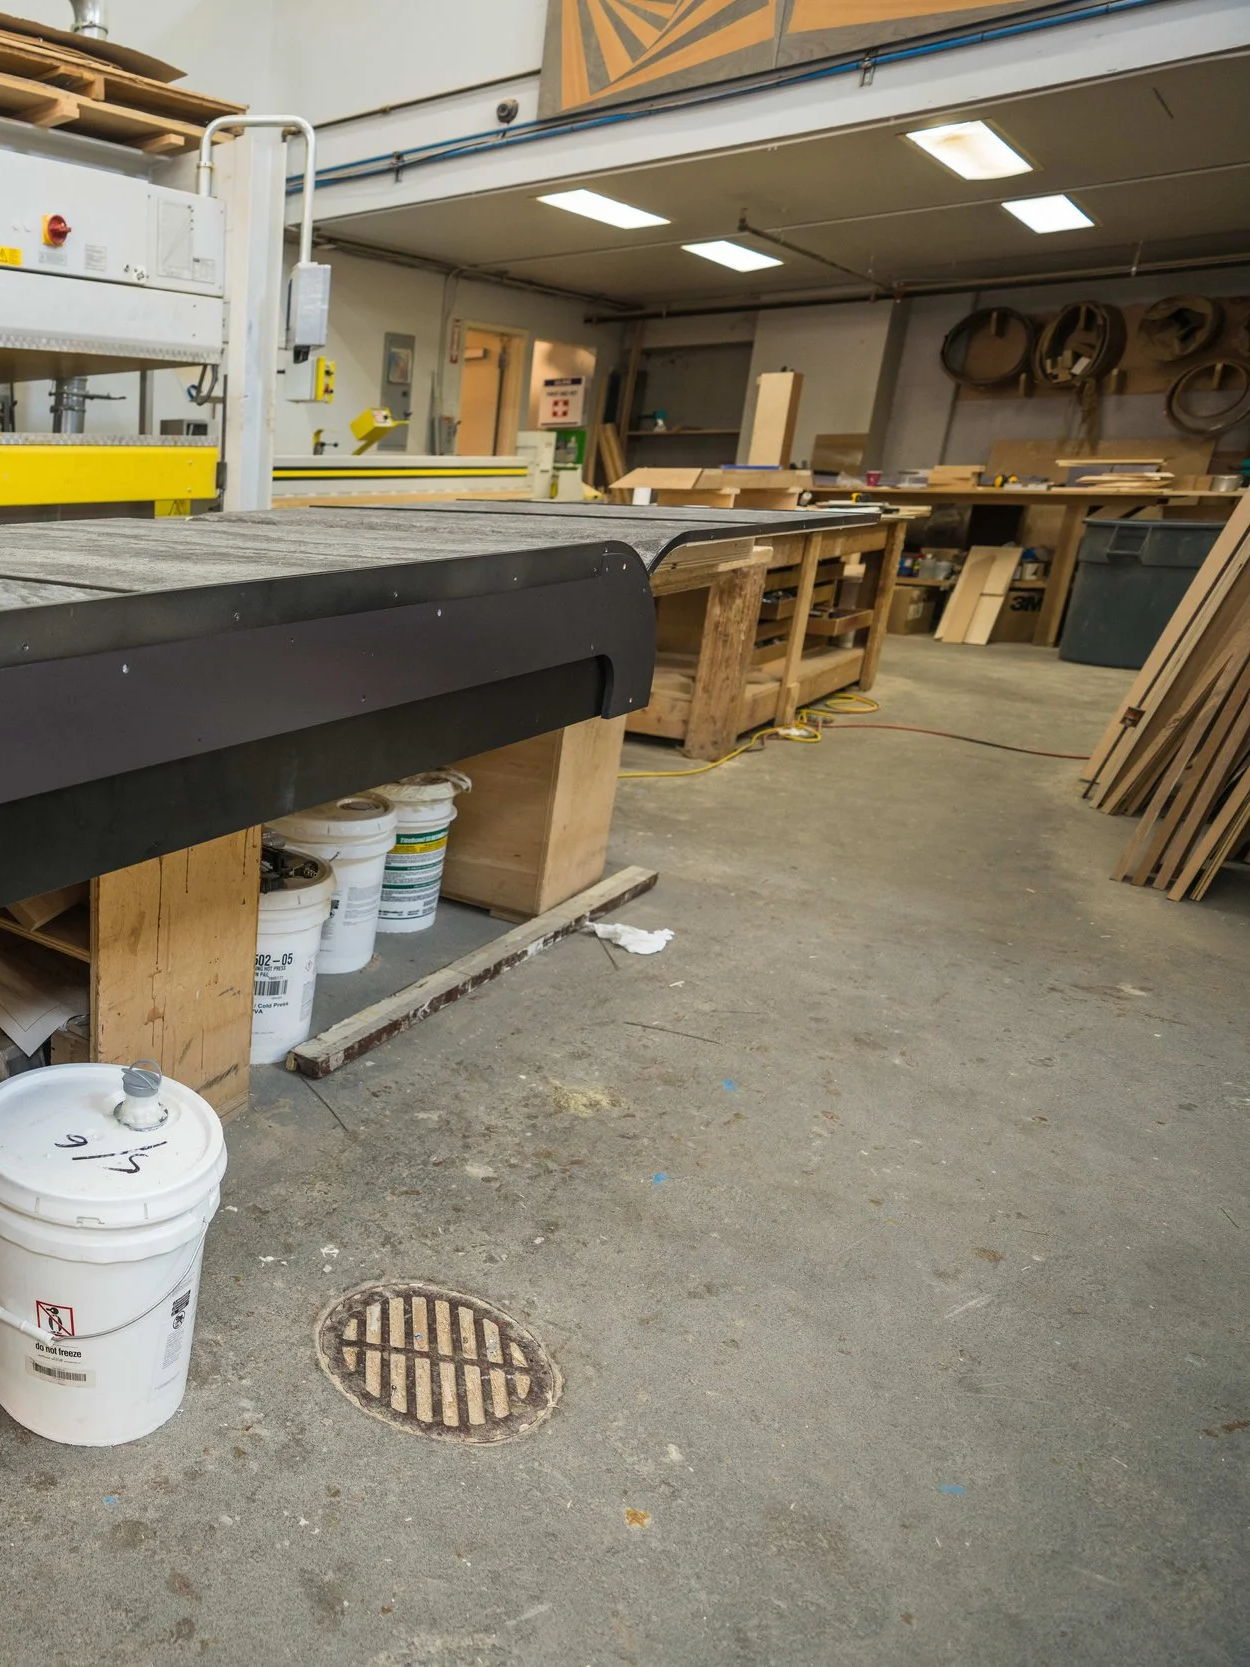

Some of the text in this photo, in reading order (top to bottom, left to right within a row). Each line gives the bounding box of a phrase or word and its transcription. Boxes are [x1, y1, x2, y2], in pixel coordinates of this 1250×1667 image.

[35, 1342, 82, 1358] do not freeze
